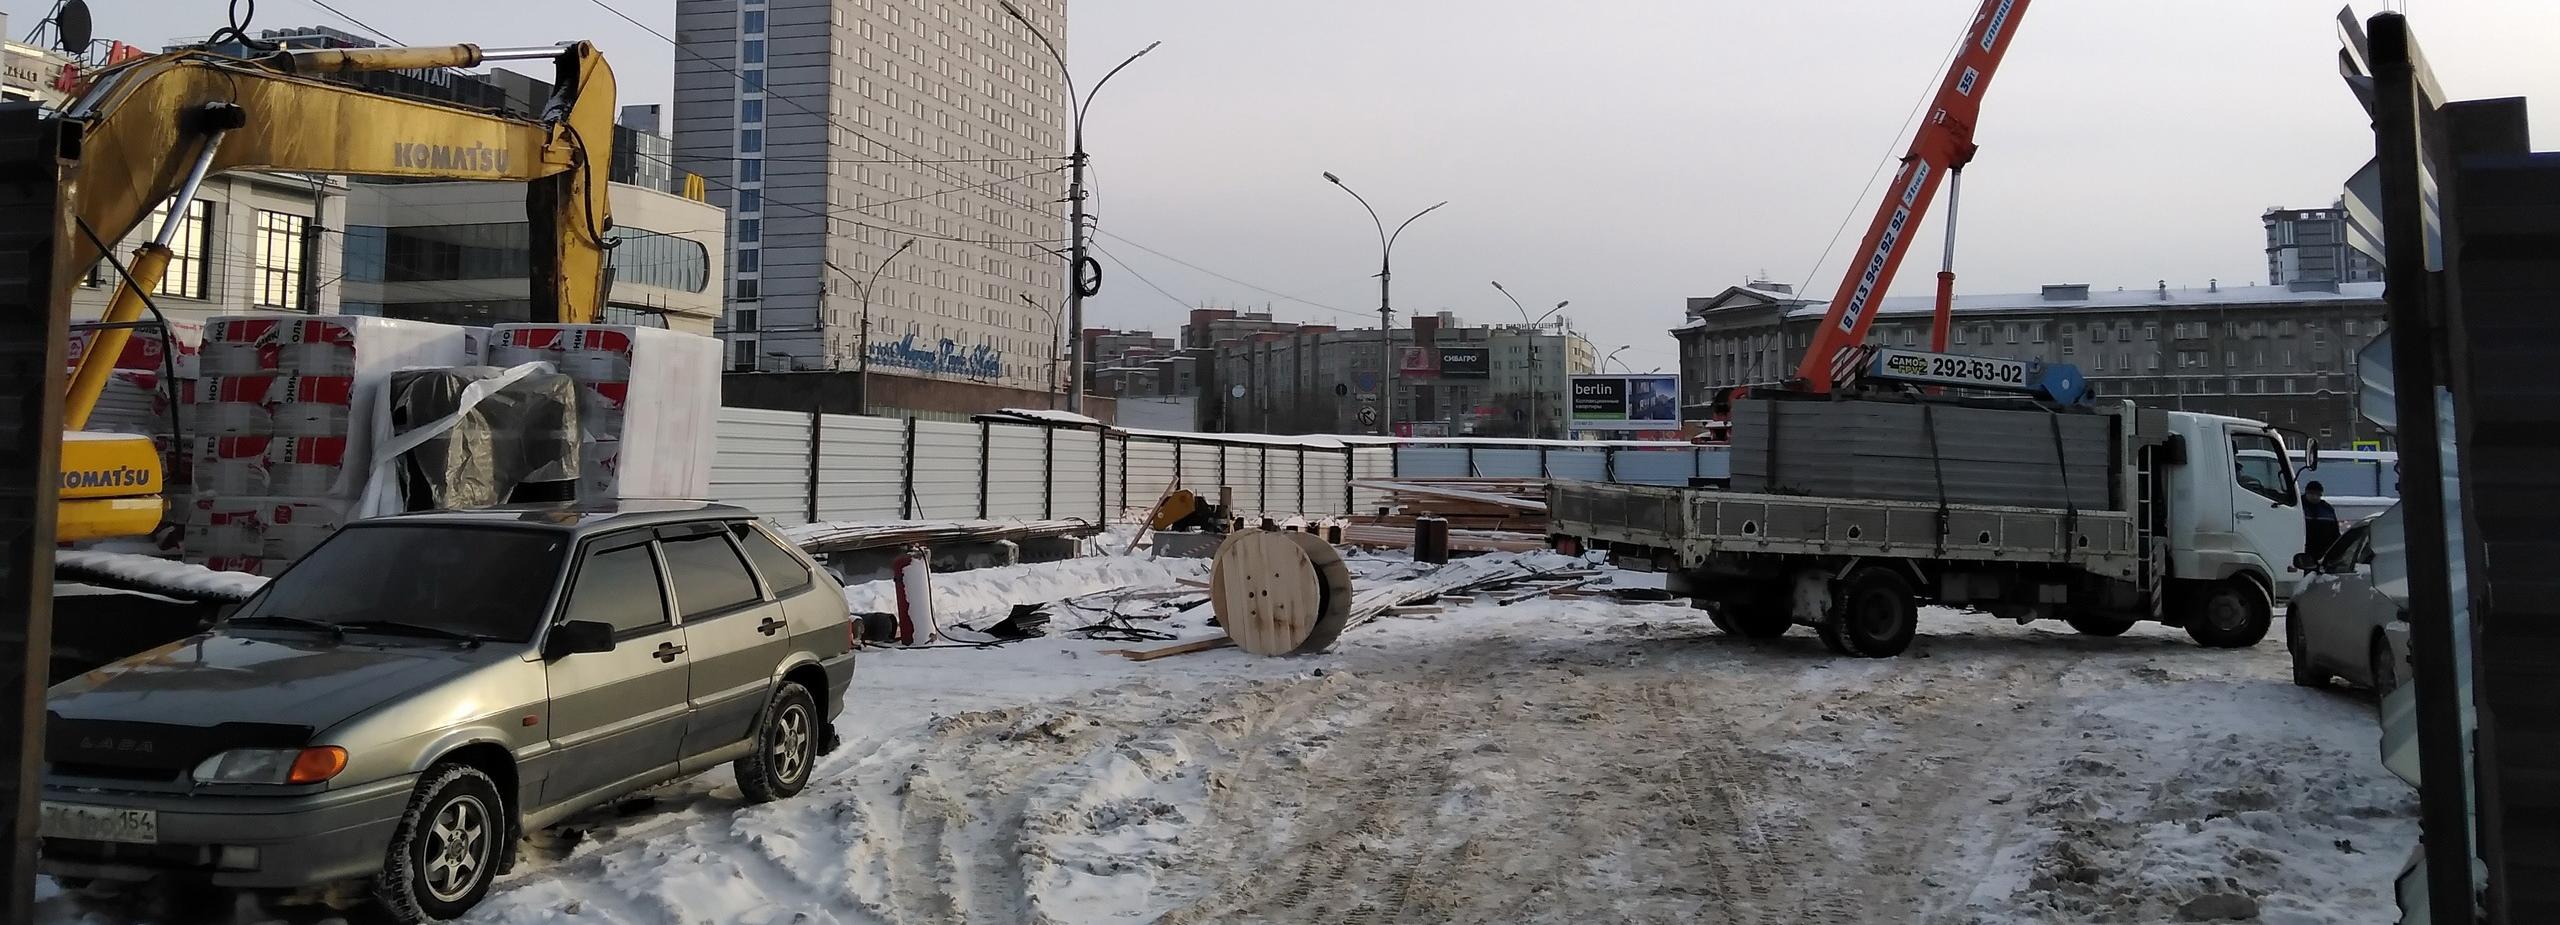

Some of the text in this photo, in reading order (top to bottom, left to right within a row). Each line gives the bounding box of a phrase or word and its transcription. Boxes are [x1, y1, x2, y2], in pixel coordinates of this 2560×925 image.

[1983, 0, 2012, 48] КЛИНЦ
[394, 140, 509, 173] KOMATSU
[1843, 210, 1906, 329] 8 913 949 92 92
[292, 320, 302, 342] ОЛЬ
[1443, 354, 1477, 363] СИБАГРО
[1933, 357, 2022, 384] 292-63-02
[1575, 383, 1612, 395] berlin
[120, 811, 151, 831] 154
